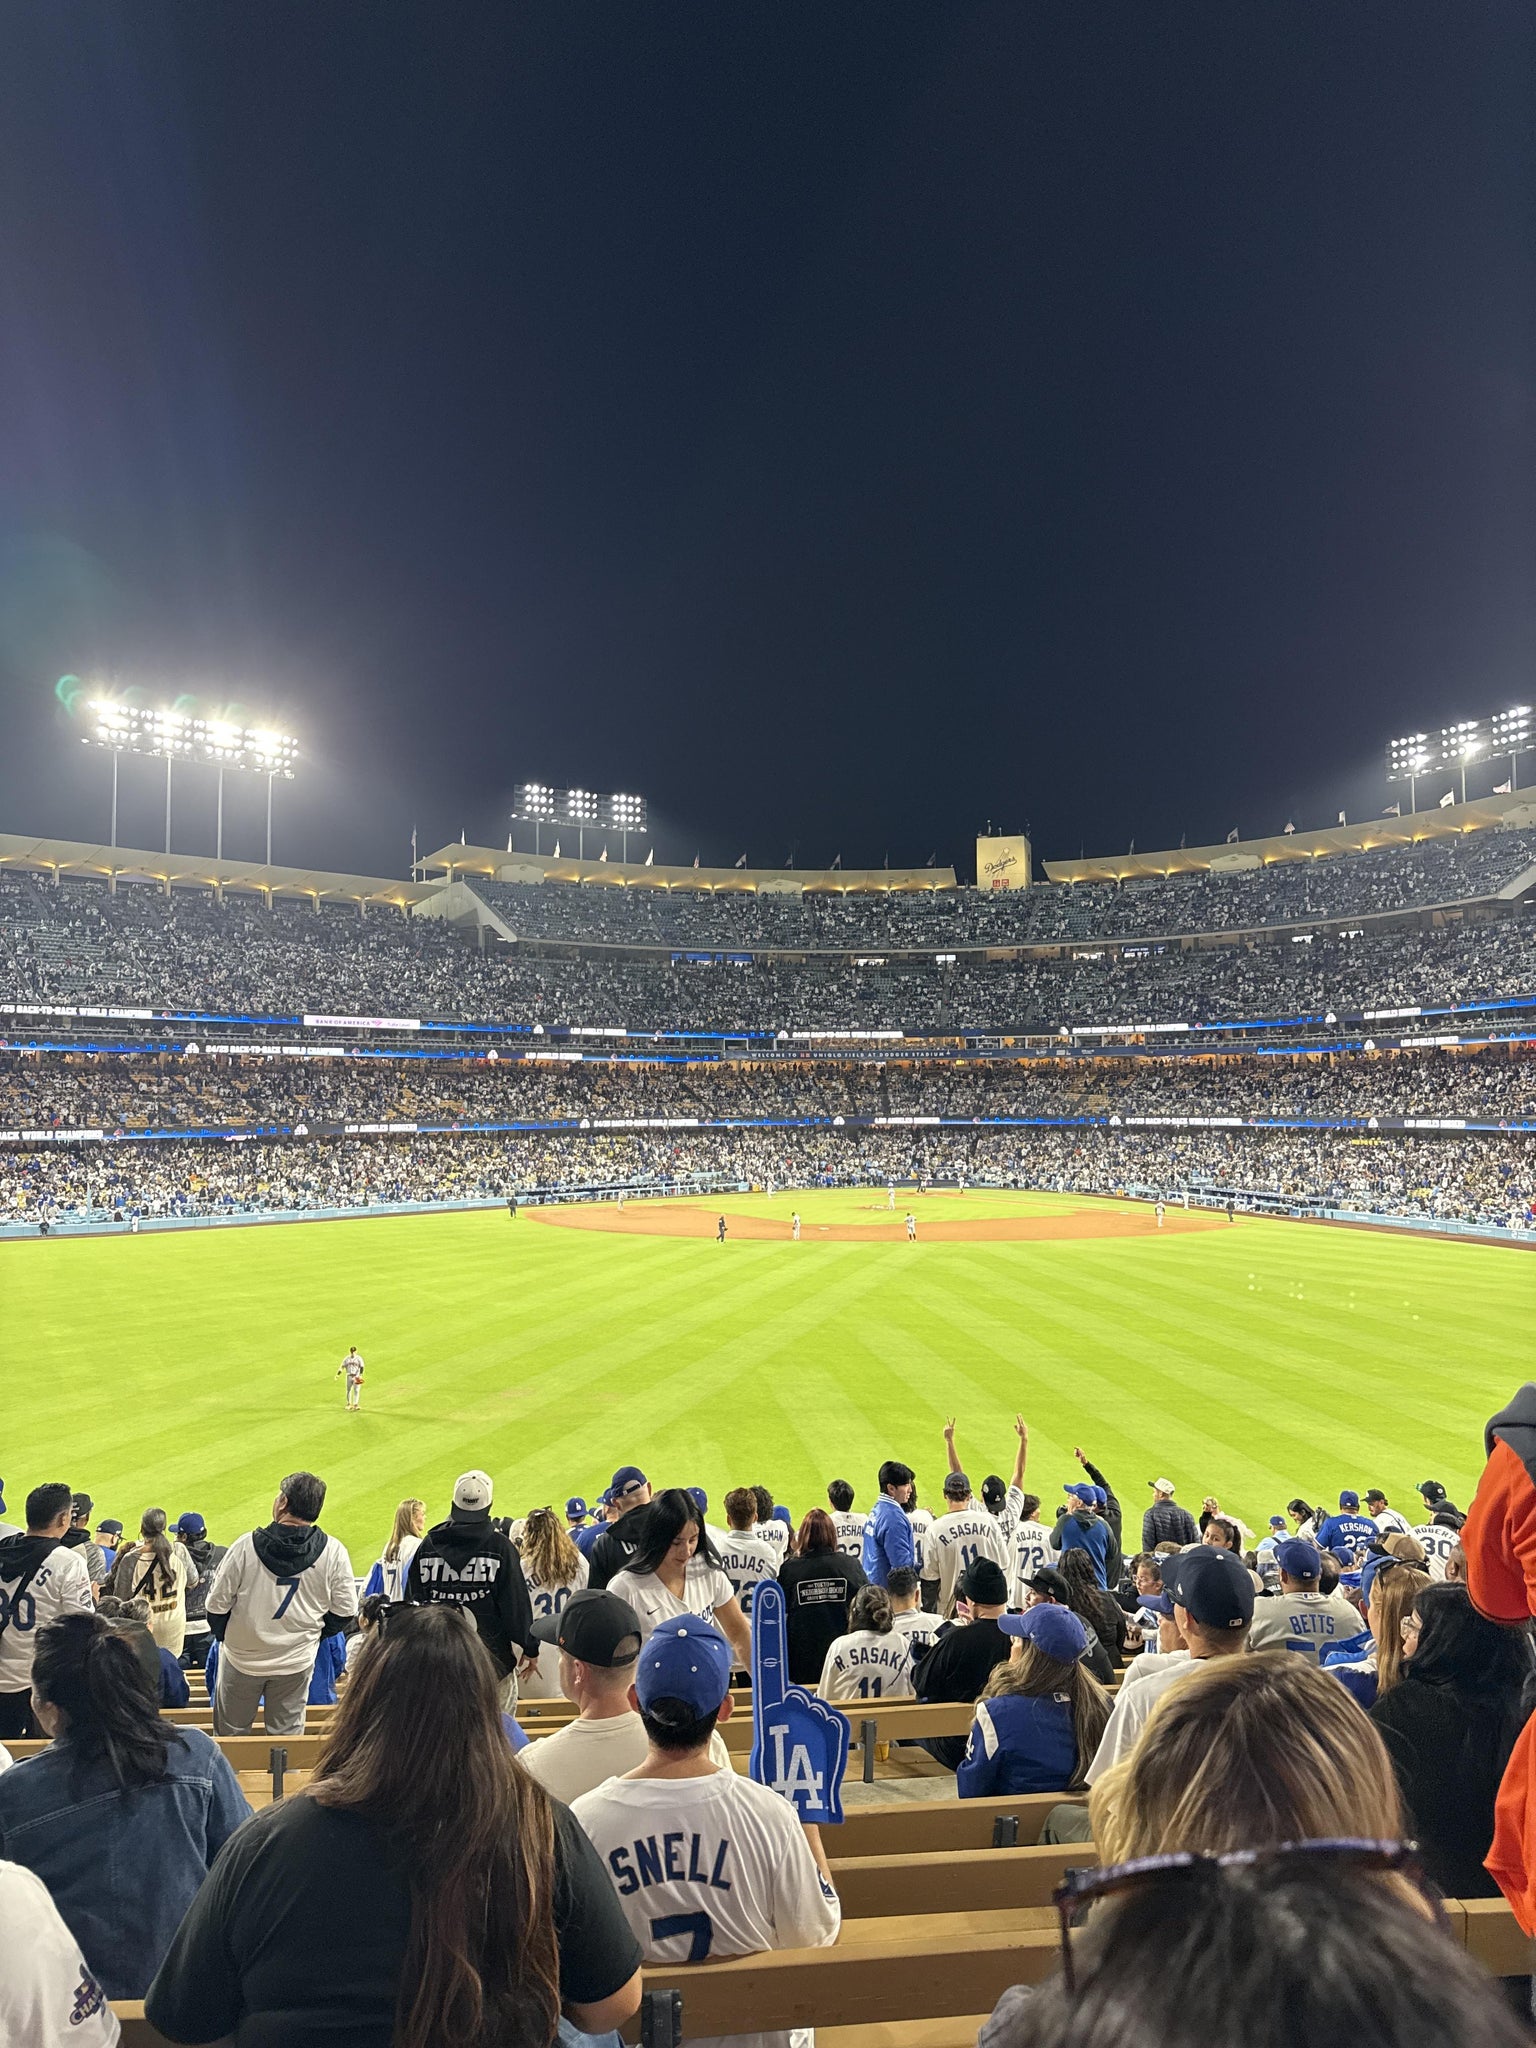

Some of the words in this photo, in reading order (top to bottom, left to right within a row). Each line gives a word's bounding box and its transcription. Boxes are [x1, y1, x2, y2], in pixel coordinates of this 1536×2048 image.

[984, 856, 1017, 874] Dodgers
[950, 1522, 991, 1539] SASAKI
[1016, 1531, 1043, 1544] ROJAS
[1338, 1522, 1374, 1536] KERSHAW
[960, 1542, 979, 1571] 11
[1017, 1546, 1044, 1570] 72
[1419, 1536, 1454, 1560] 30
[723, 1553, 766, 1574] ROJAS
[387, 1568, 397, 1597] 7
[271, 1577, 300, 1620] 7
[1288, 1613, 1335, 1635] BETTS
[858, 1676, 882, 1699] 11
[768, 1724, 824, 1810] LA
[608, 1831, 732, 1896] SNELL
[650, 1910, 714, 1962] 7
